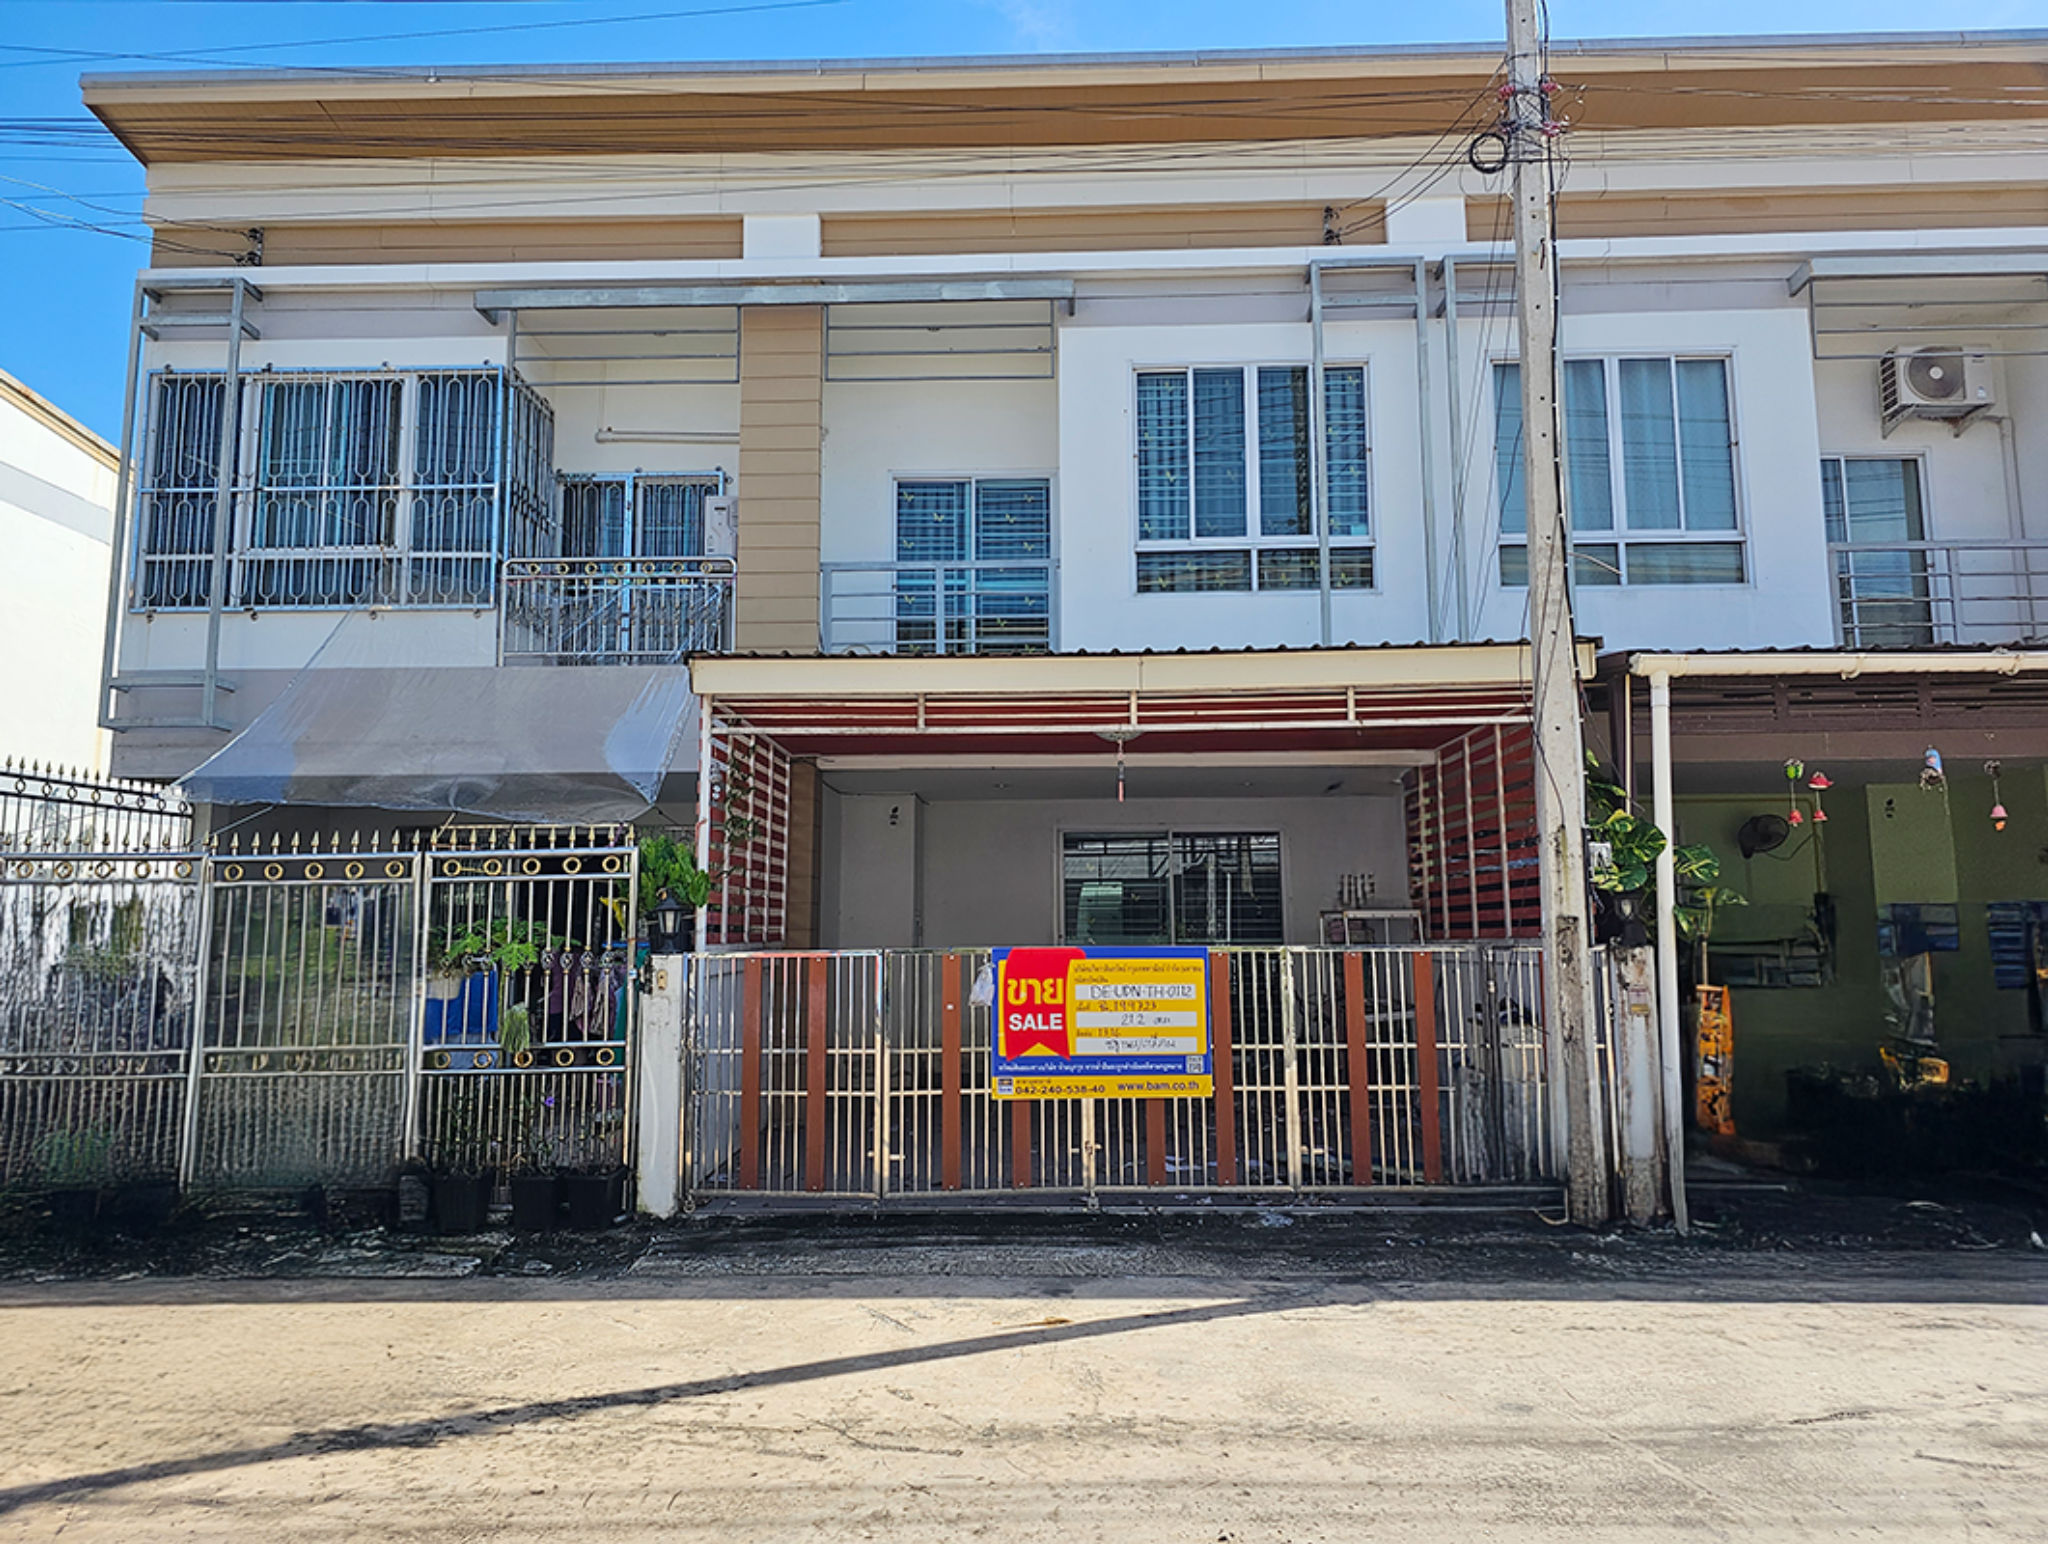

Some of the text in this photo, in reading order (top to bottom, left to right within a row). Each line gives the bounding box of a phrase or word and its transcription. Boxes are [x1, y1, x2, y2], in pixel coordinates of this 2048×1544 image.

[1008, 978, 1063, 1006] ขาย
[1009, 1013, 1063, 1031] SALE
[1118, 1080, 1199, 1091] www.bam.co.th
